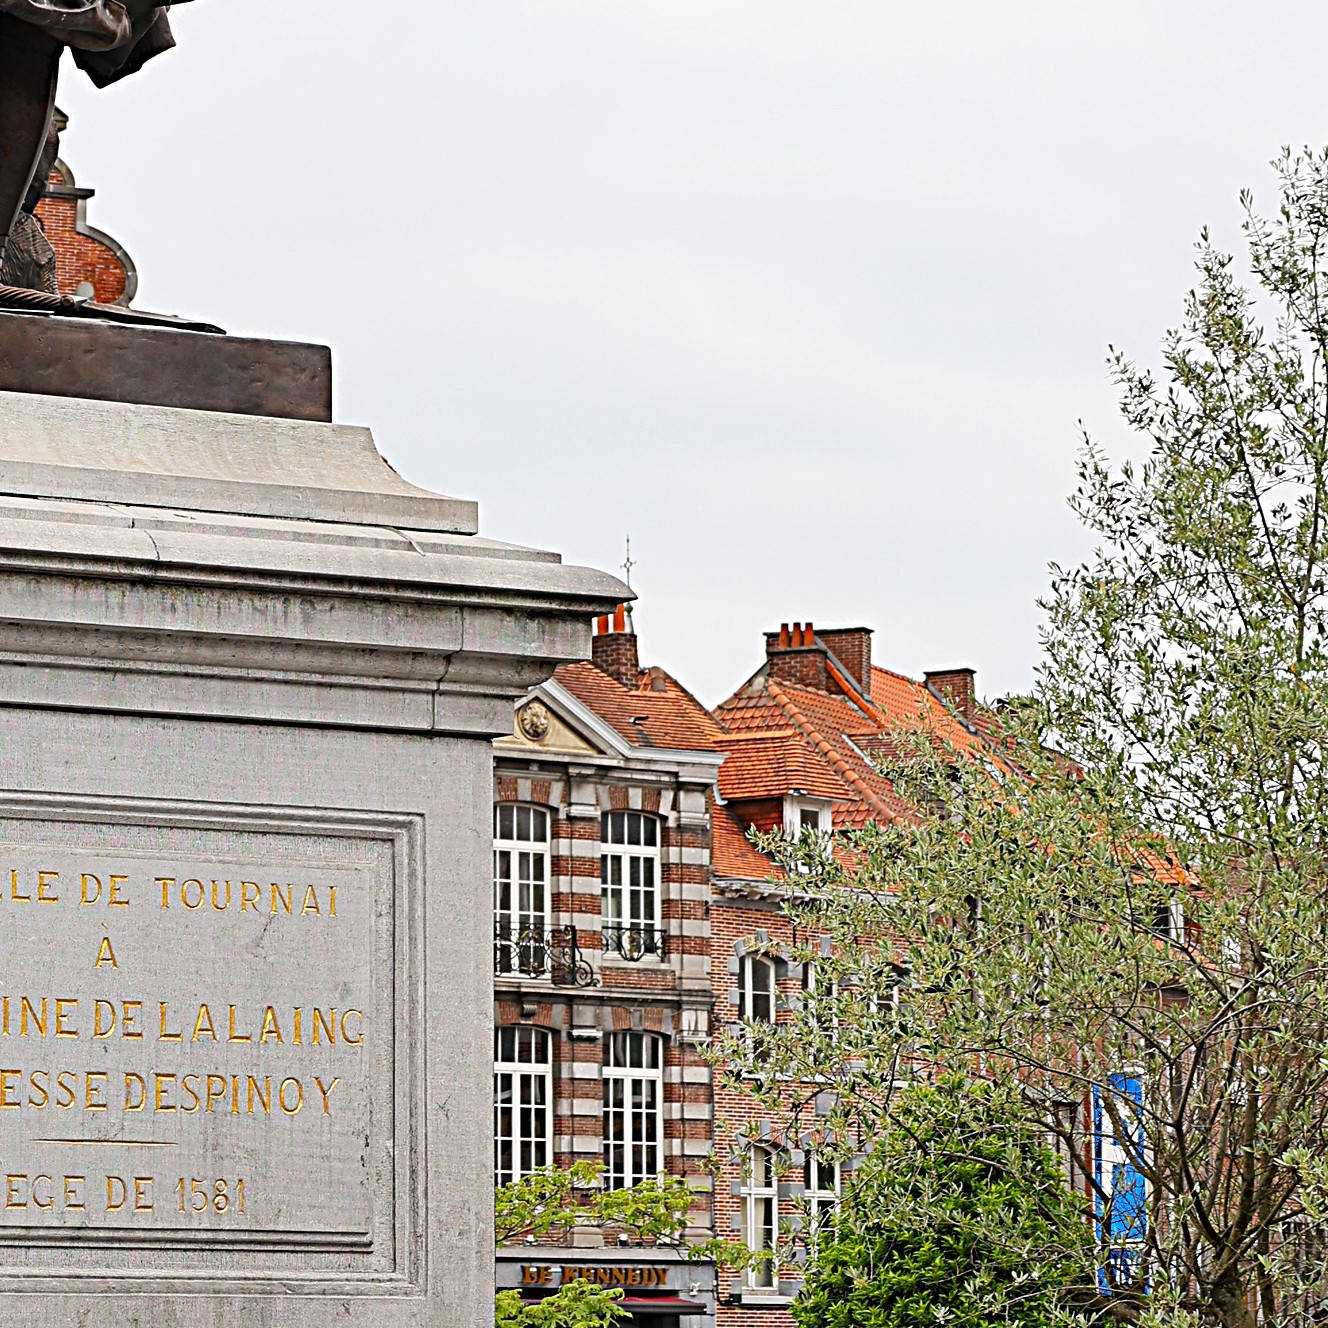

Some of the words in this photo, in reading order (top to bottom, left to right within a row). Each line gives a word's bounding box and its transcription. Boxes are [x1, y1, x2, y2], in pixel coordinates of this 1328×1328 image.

[79, 872, 130, 908] DE
[154, 878, 339, 918] TOURNAI
[93, 1000, 144, 1041] DE
[158, 1001, 365, 1048] LALAING
[105, 1176, 154, 1214] DE
[174, 1177, 246, 1215] 1581
[521, 1265, 553, 1284] LE
[561, 1265, 670, 1286] KENNEDY
